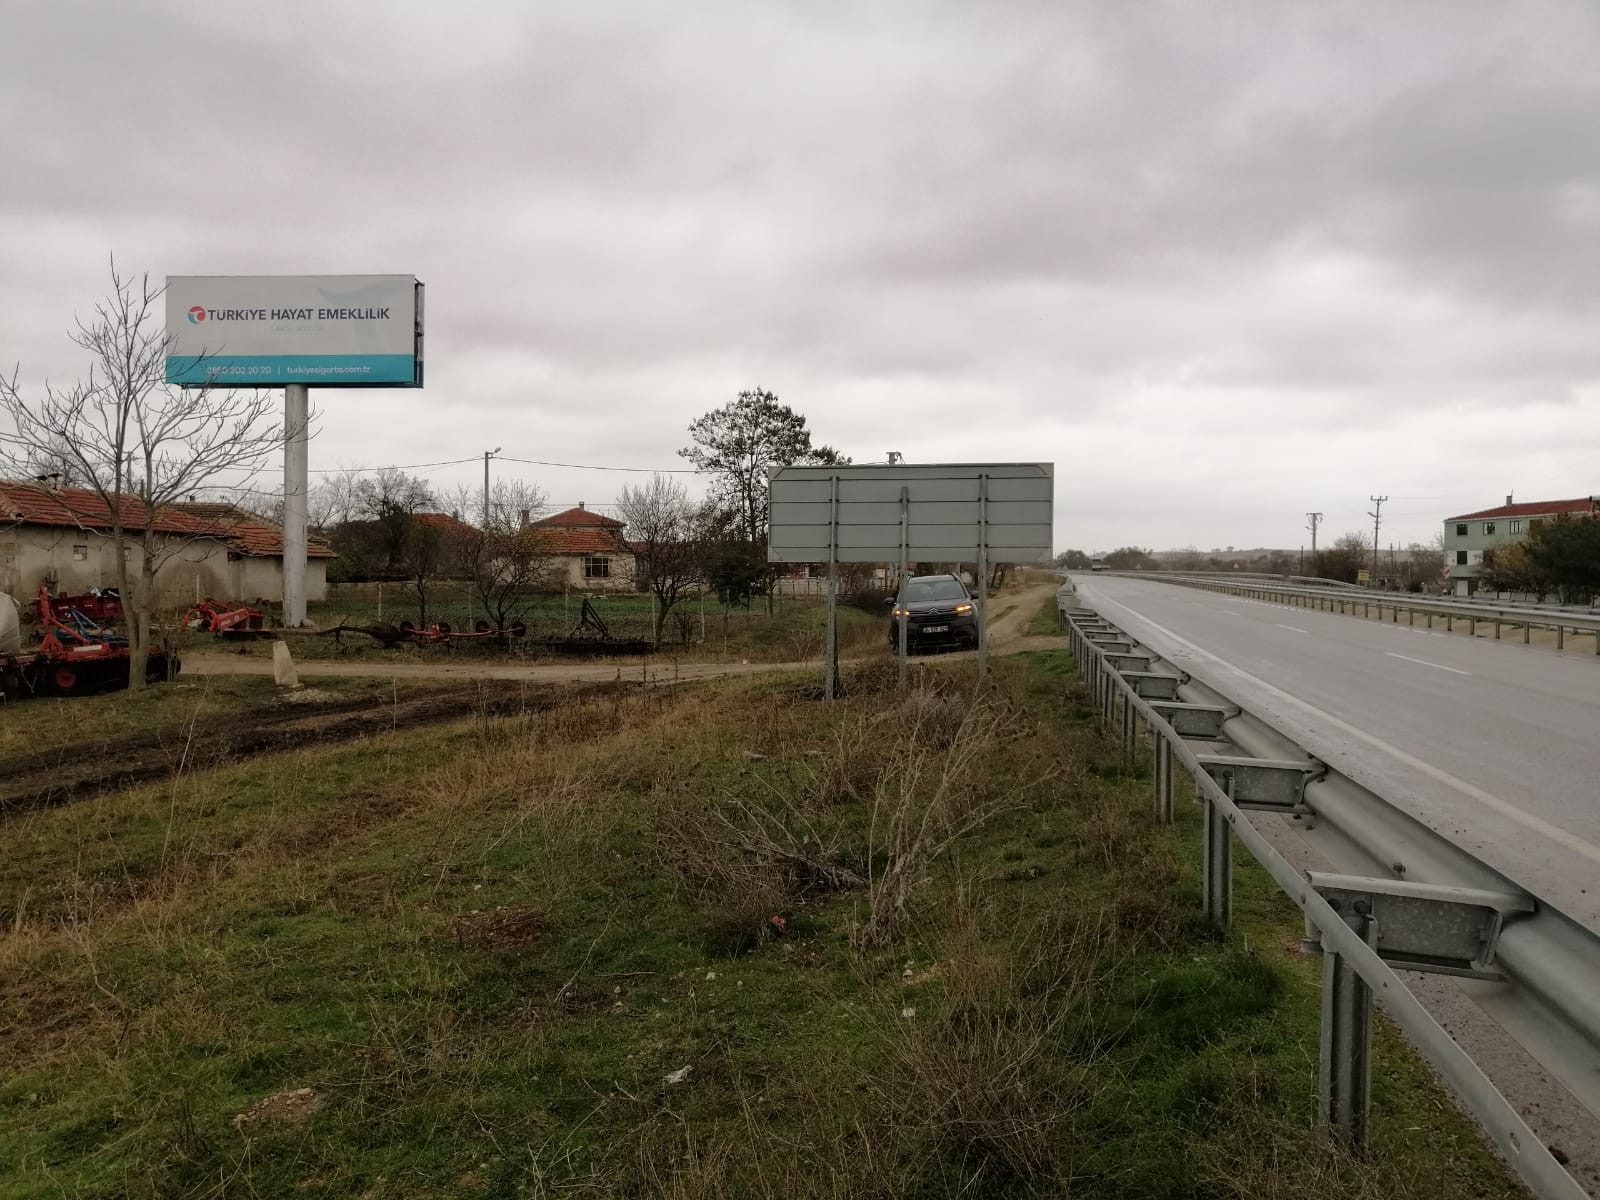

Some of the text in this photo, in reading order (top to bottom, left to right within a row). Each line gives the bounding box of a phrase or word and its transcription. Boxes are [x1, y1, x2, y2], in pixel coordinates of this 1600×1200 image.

[207, 307, 391, 321] TÜRKİYE HAYAT EMEKLİLİK
